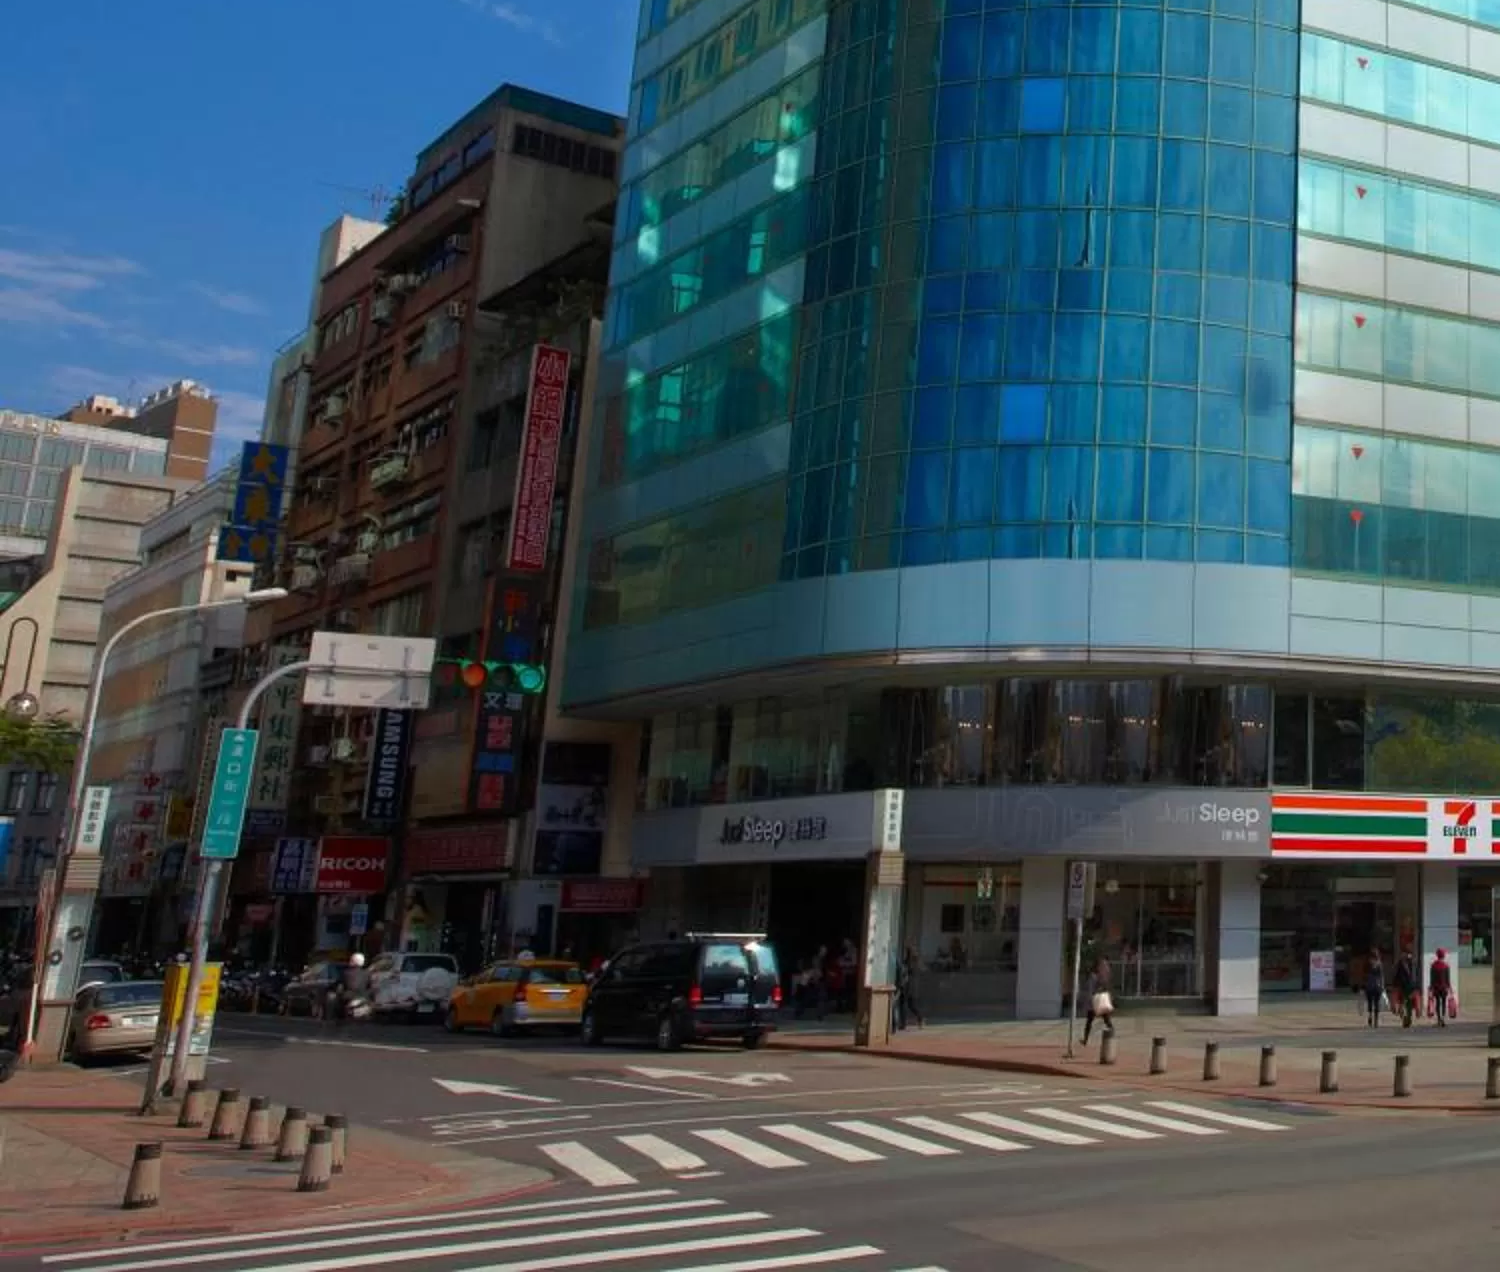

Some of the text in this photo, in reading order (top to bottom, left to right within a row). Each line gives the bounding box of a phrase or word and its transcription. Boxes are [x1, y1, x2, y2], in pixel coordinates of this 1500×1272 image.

[375, 711, 404, 799] AMSUNG
[1199, 802, 1260, 827] Sleep
[743, 814, 784, 849] Sleep
[319, 855, 386, 873] RICOH
